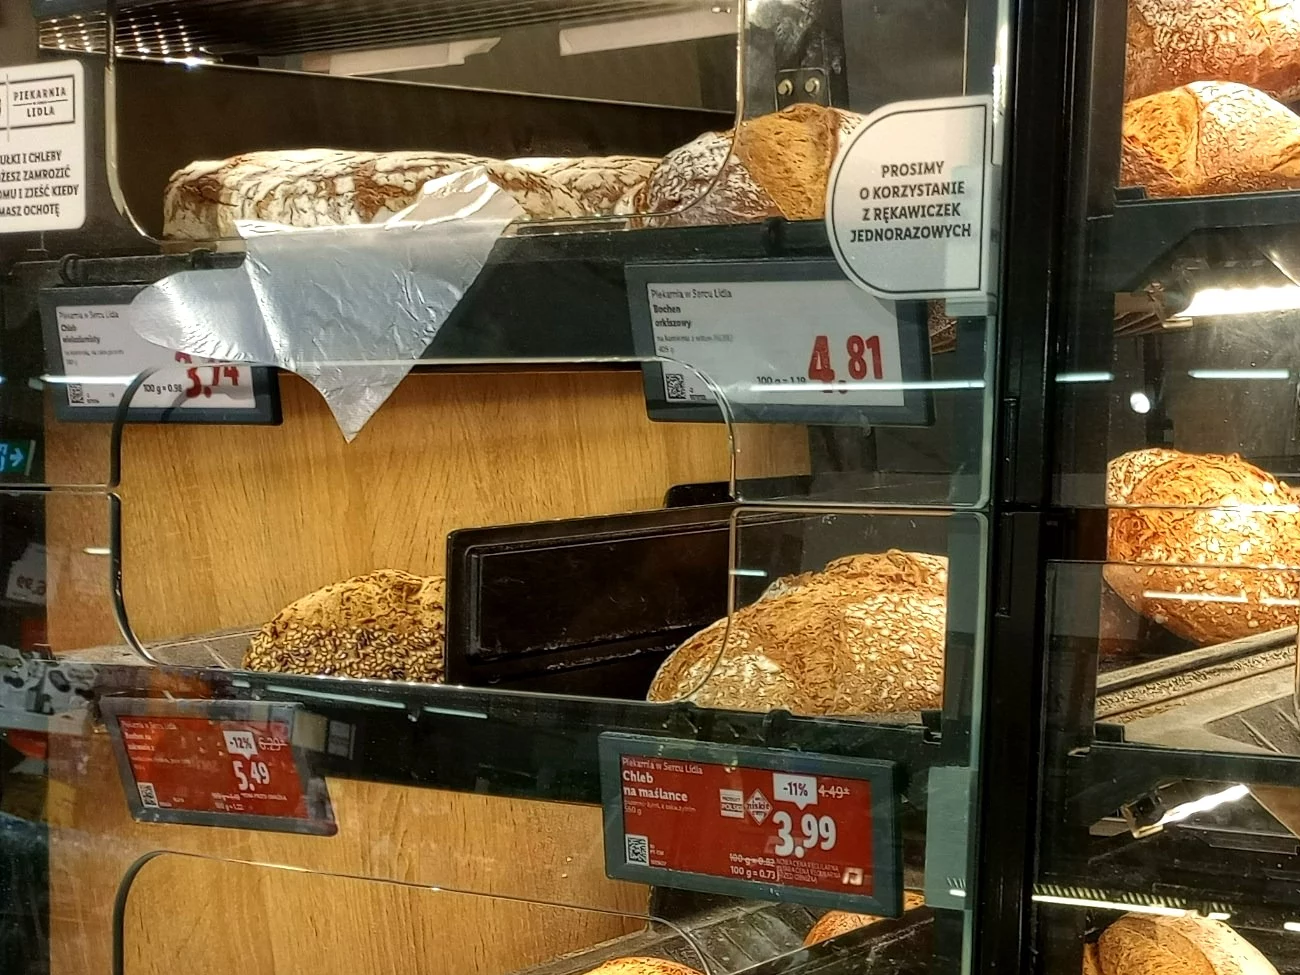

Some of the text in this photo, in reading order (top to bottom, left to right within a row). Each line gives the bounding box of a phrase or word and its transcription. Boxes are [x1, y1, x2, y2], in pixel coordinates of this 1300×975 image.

[13, 87, 67, 101] PIEKARNIA
[26, 106, 55, 117] LIDLA
[0, 150, 62, 165] UŁKI I CHLEBY
[23, 164, 71, 180] ZAMROZIĆ
[881, 160, 945, 178] PROSIMY
[18, 188, 23, 199] I
[24, 184, 51, 198] ZJEŚĆ
[52, 184, 79, 196] KIEDY
[859, 181, 965, 200] O KORZYSTANIE
[23, 203, 60, 217] OCHOTĘ
[862, 202, 961, 224] Z RĘKAWICZEK
[850, 223, 971, 243] JEDNORAZOWYCH
[143, 384, 155, 392] 100
[230, 737, 252, 749] -12%
[232, 760, 270, 791] 5.49
[622, 770, 654, 784] Chleb
[623, 787, 688, 802] na maślance
[783, 781, 808, 797] -11%
[772, 810, 836, 858] 3.99
[730, 865, 744, 875] 100
[746, 870, 752, 879] g
[759, 869, 776, 880] 0.73
